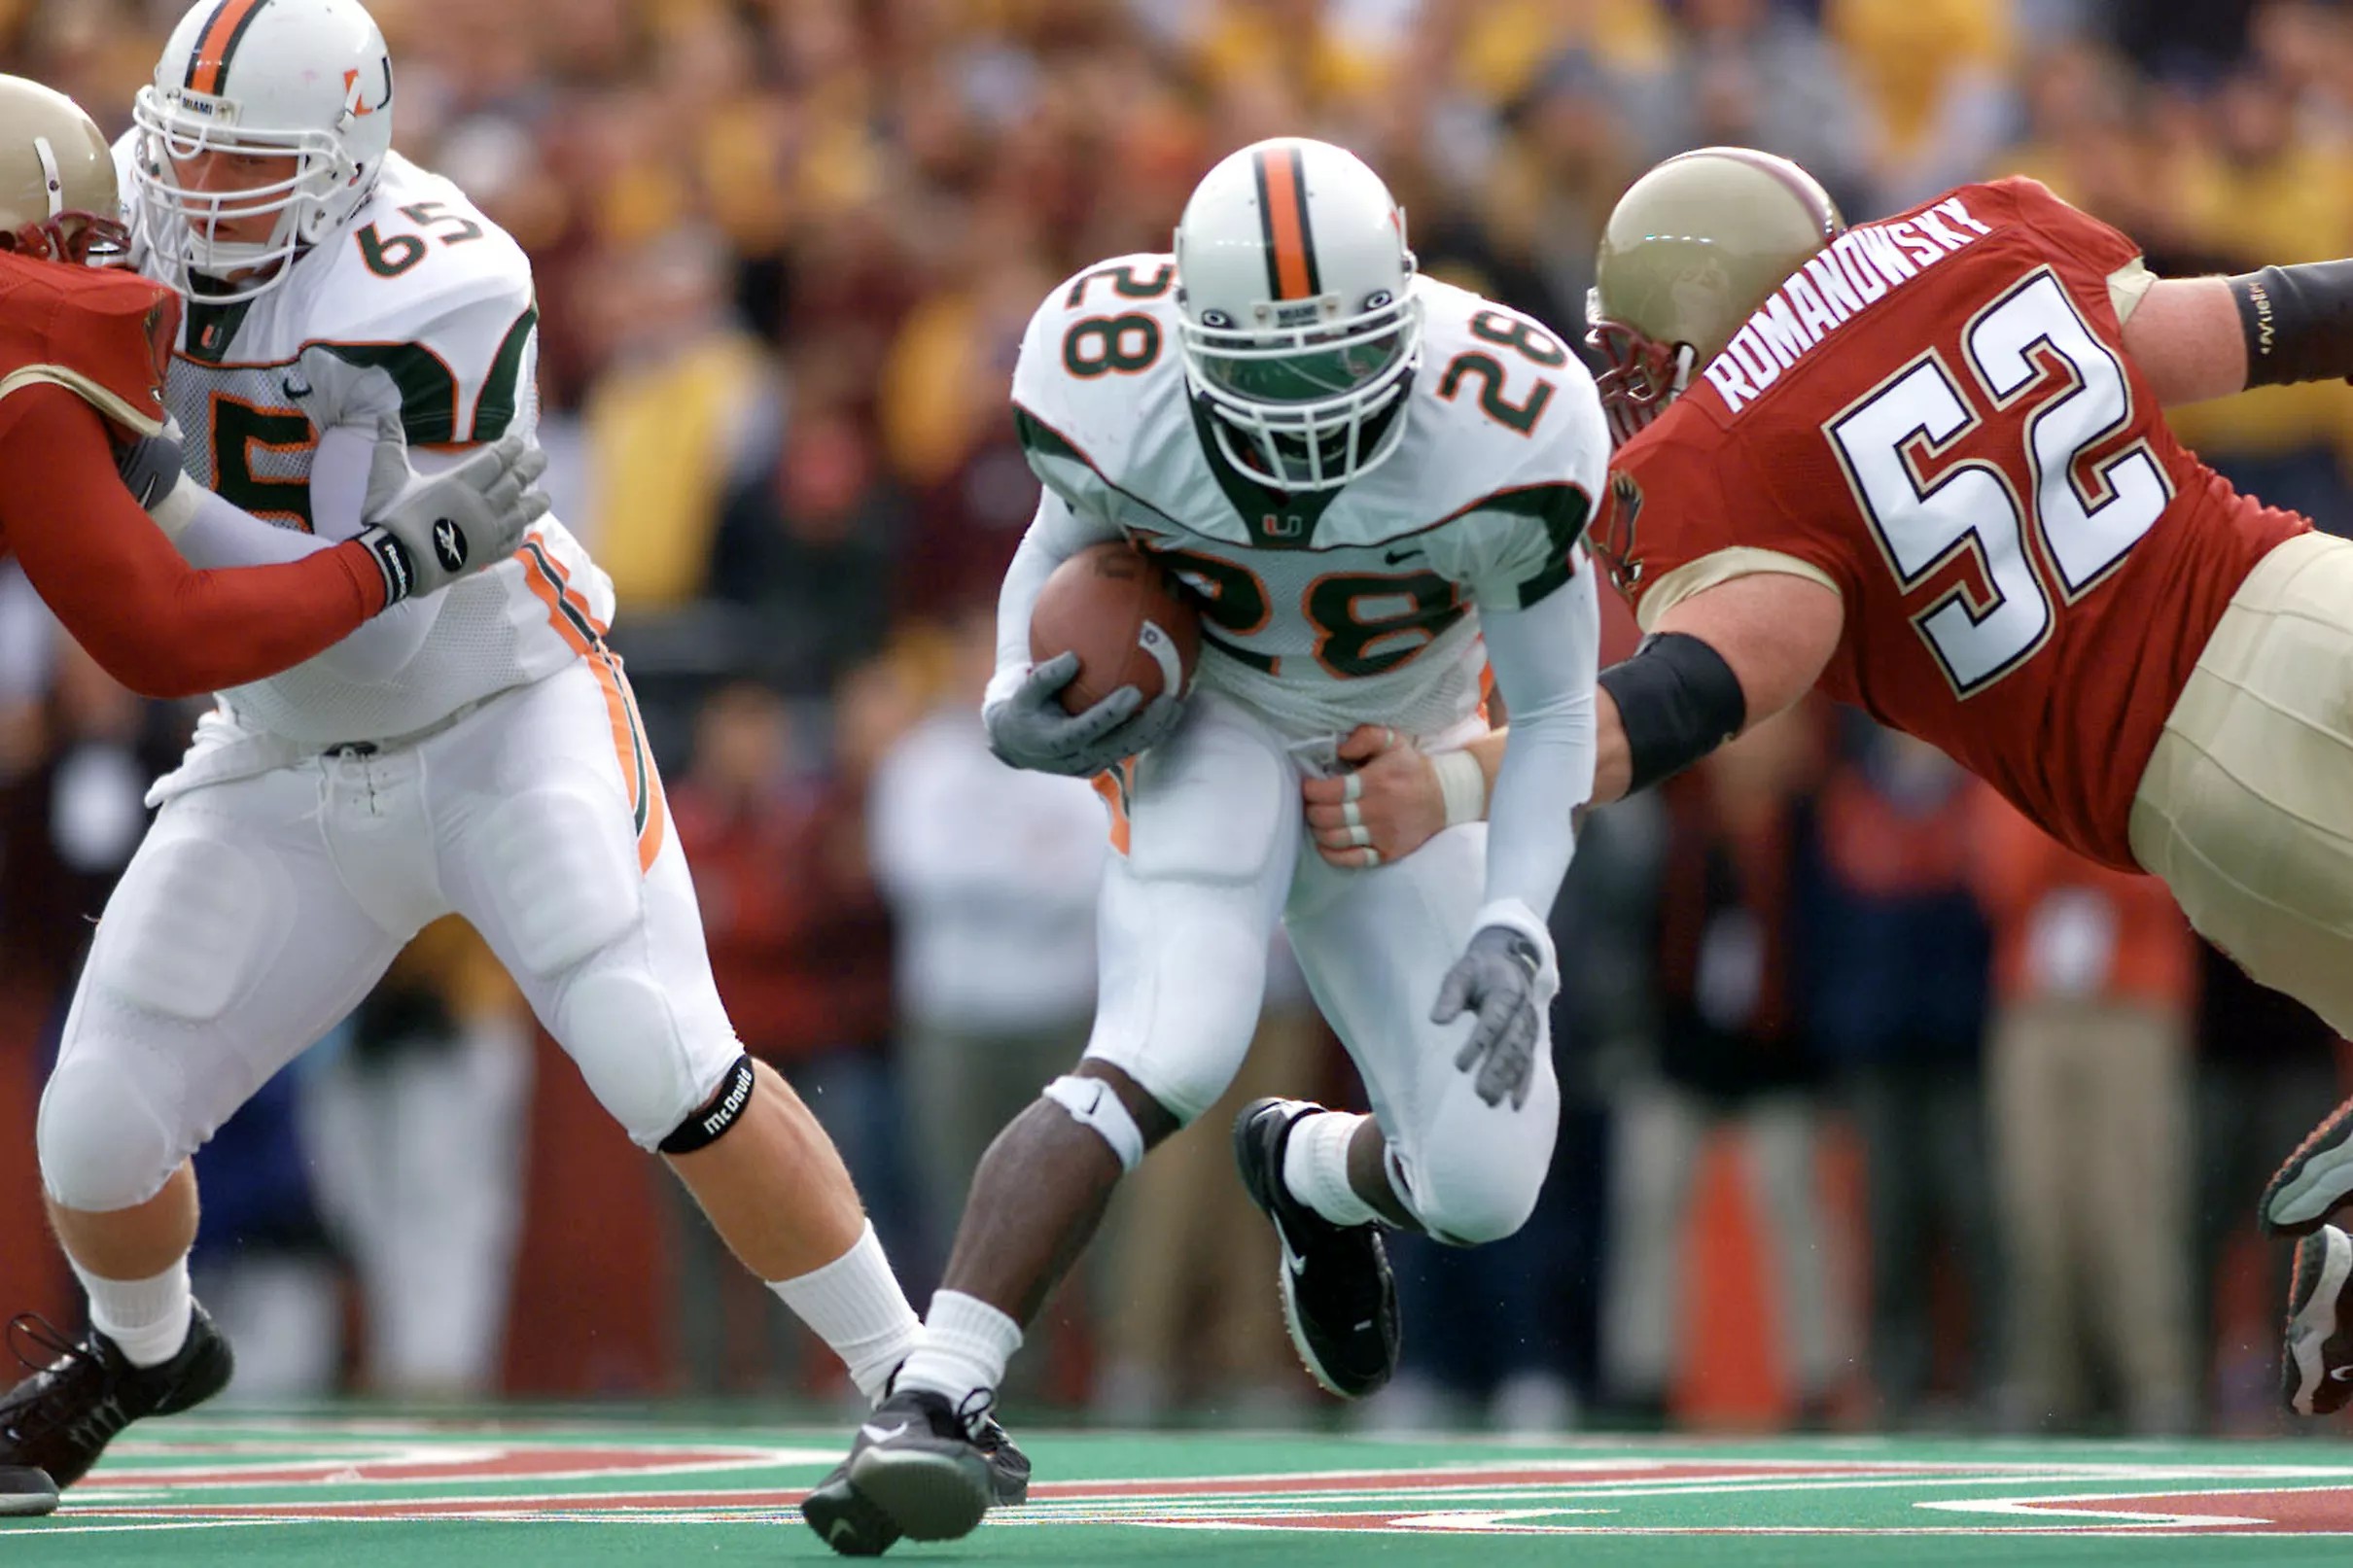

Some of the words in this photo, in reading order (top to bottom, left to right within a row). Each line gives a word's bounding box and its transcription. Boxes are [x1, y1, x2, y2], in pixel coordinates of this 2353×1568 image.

[181, 96, 213, 116] MIAMI
[354, 201, 484, 280] 65
[1062, 263, 1177, 379] 28
[1703, 196, 1992, 414] ROMANOWSKY
[1434, 309, 1569, 439] 28
[1263, 514, 1303, 536] U
[1820, 262, 2176, 702] 52
[1128, 528, 1473, 679] 28
[703, 1067, 754, 1135] McDavid
